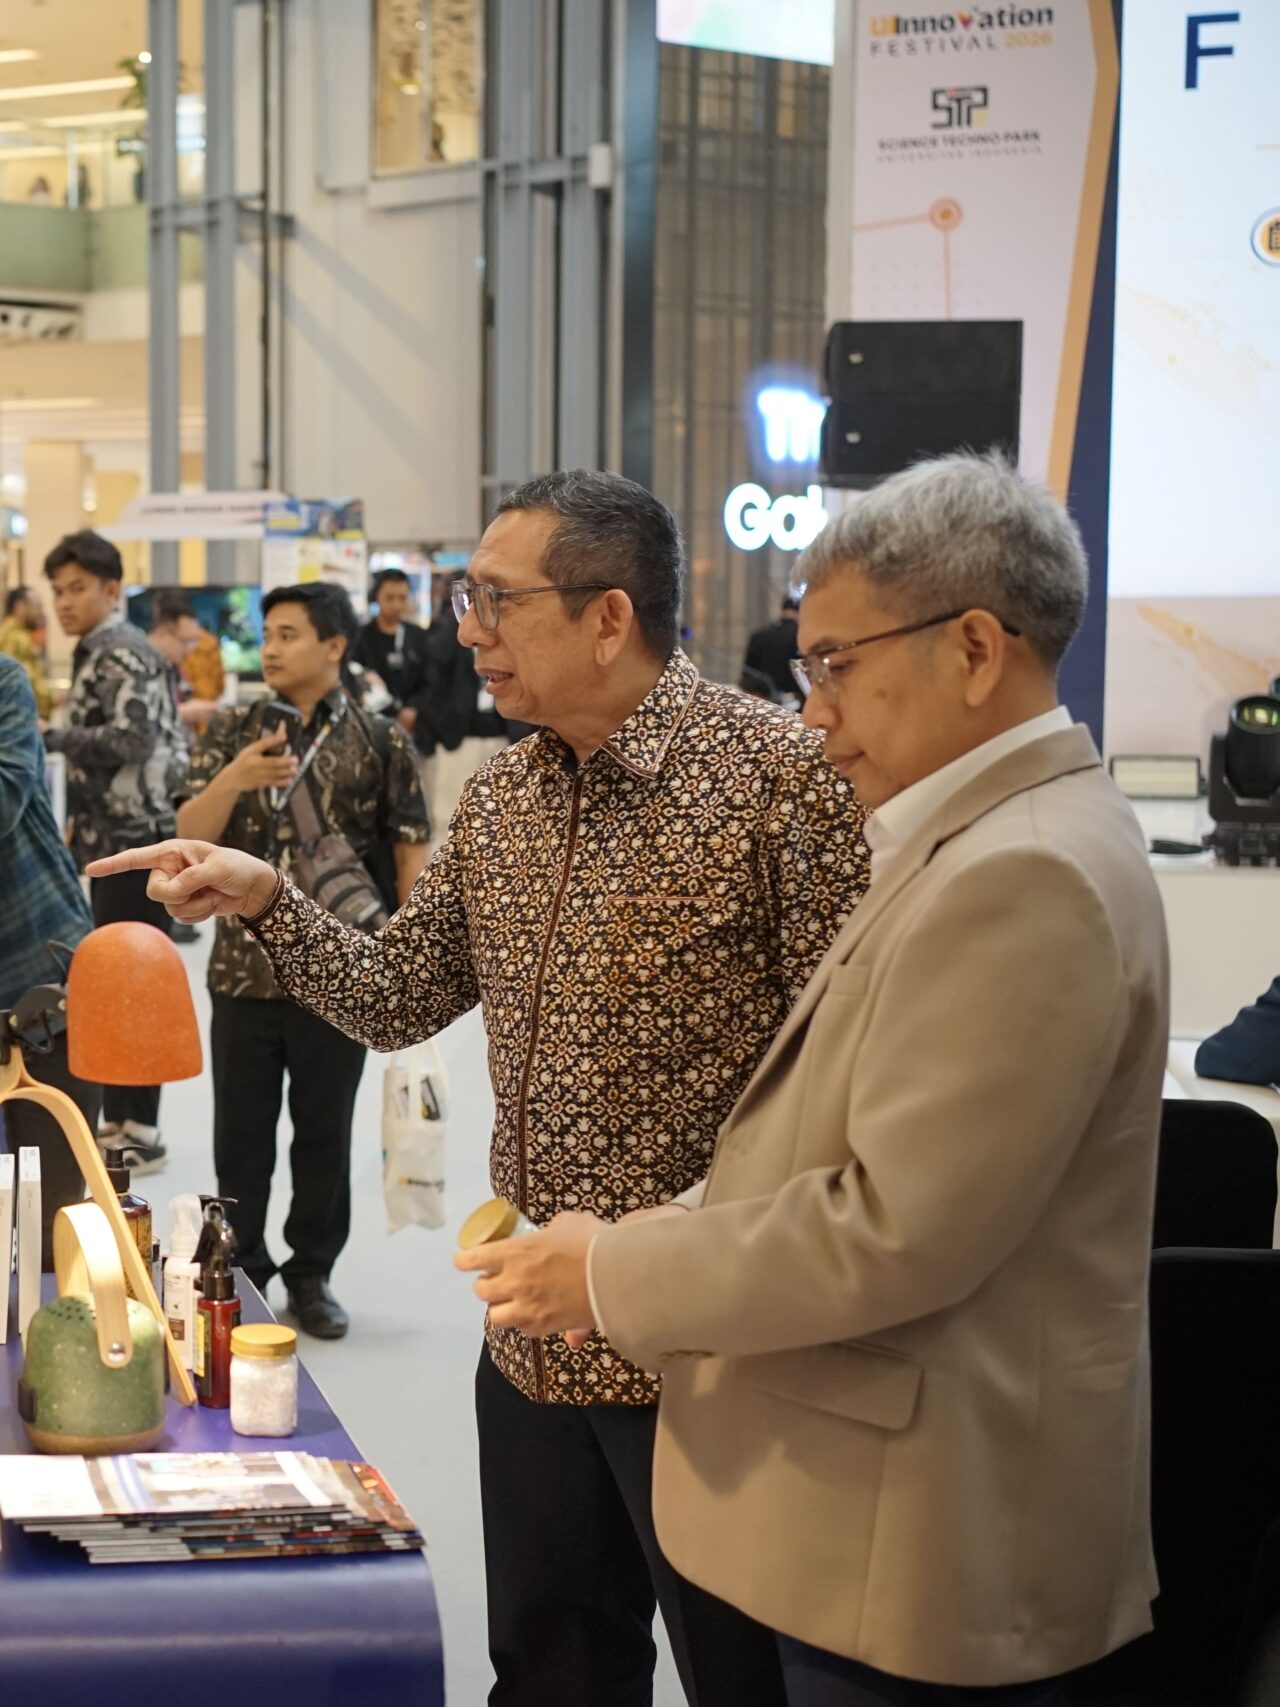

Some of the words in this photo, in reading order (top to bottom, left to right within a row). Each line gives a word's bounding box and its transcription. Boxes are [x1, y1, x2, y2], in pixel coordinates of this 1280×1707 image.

[870, 34, 999, 57] FESTIVAL
[1185, 12, 1239, 89] F
[1003, 130, 1041, 142] PARK
